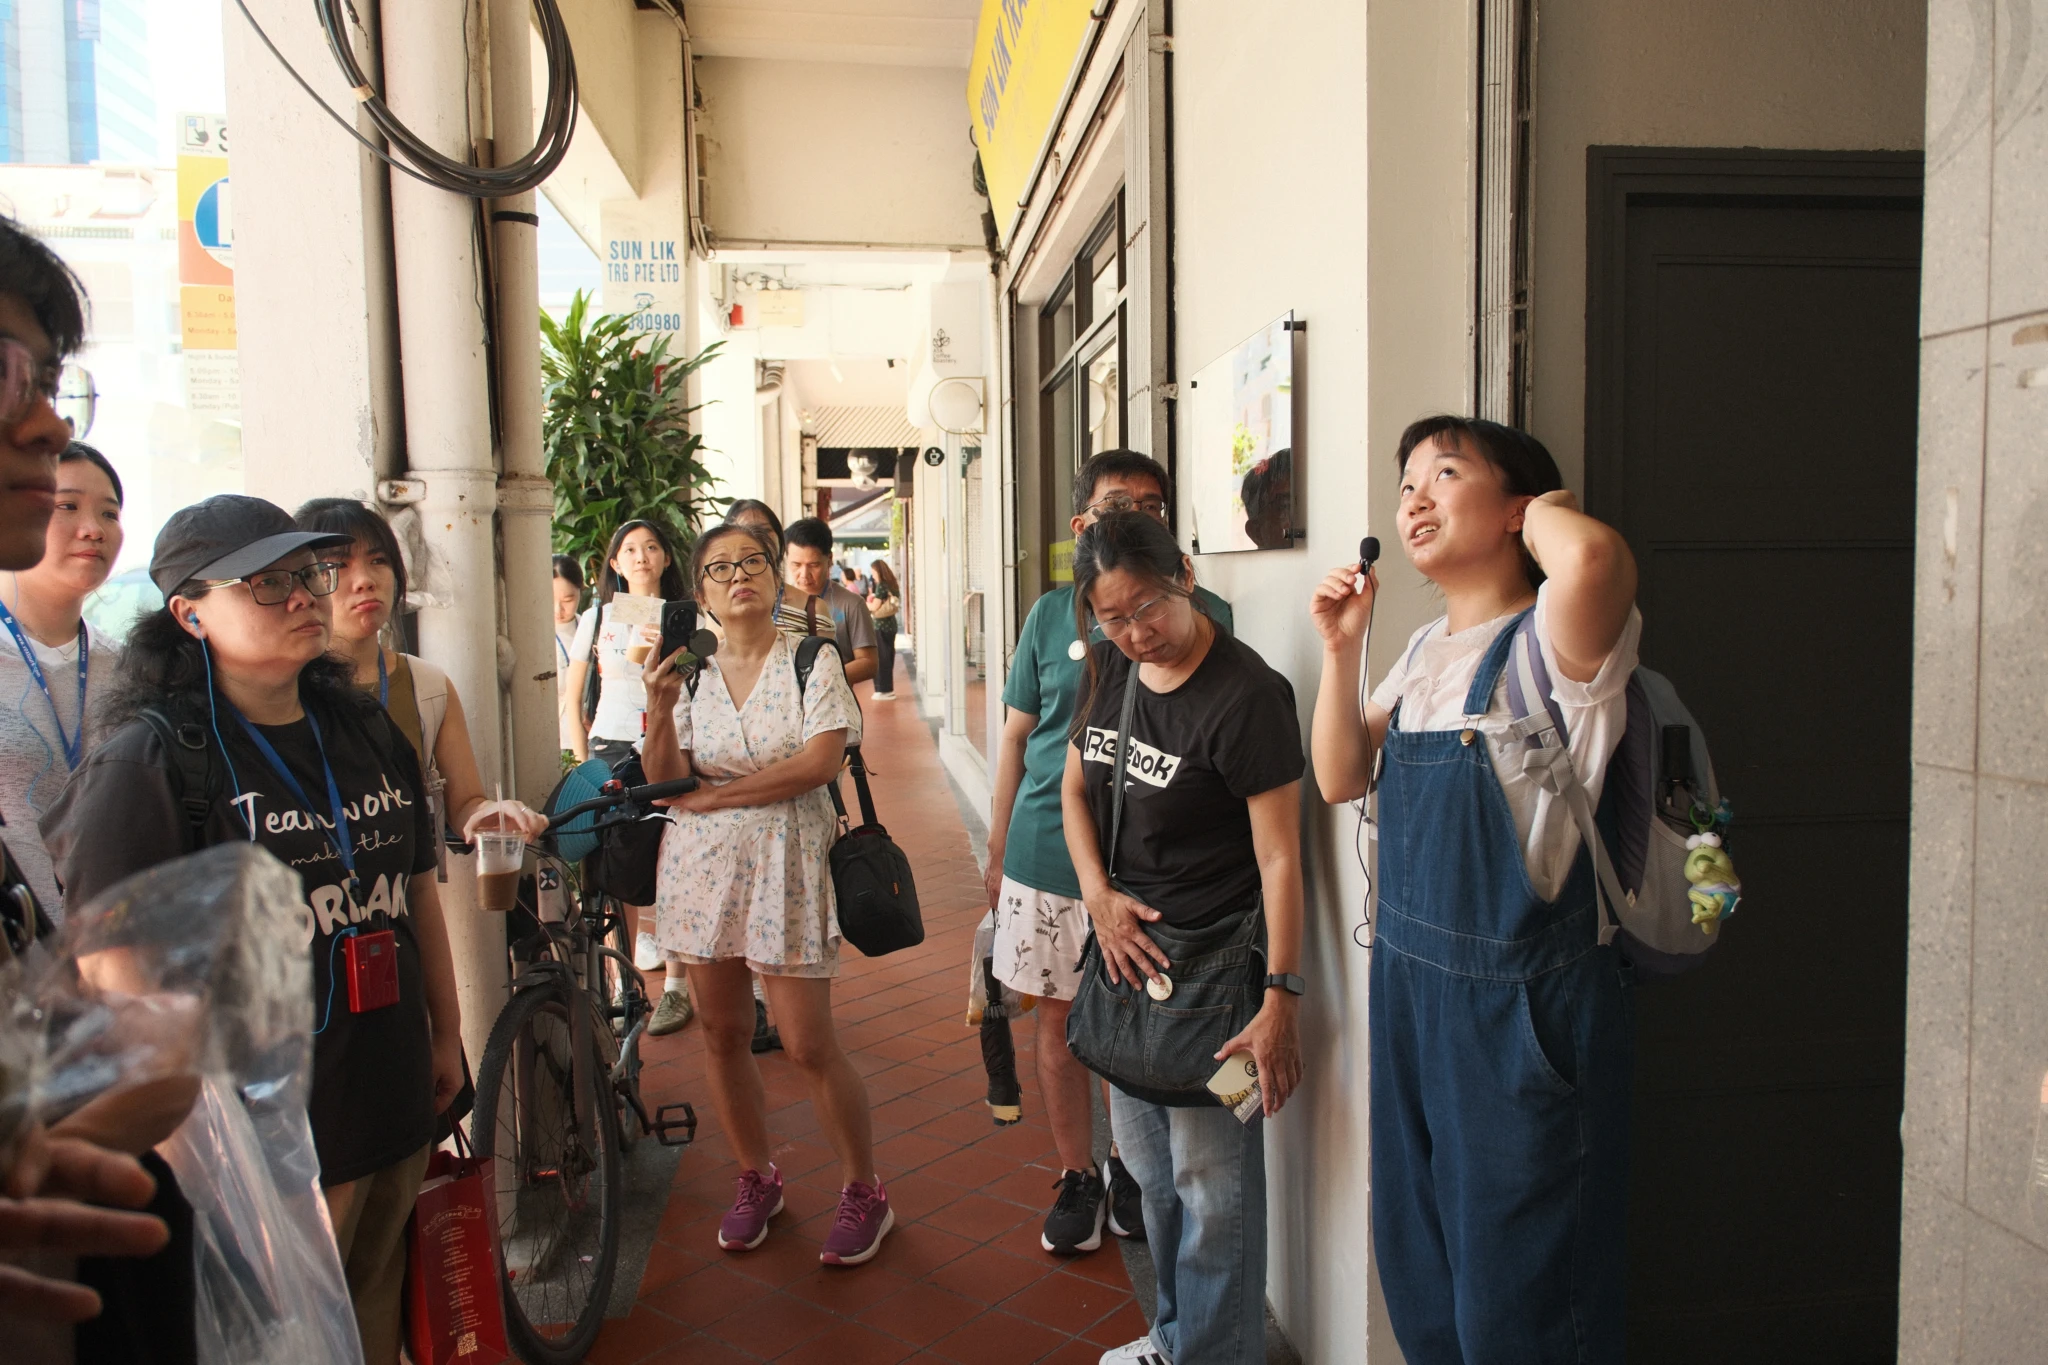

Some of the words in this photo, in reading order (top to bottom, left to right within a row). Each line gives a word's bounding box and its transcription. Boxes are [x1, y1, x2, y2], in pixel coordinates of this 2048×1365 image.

[610, 240, 642, 260] SUN
[651, 241, 675, 260] LIK
[608, 263, 629, 282] TRG
[634, 263, 655, 282] PTE
[660, 264, 679, 282] LTD
[230, 773, 412, 842] Teamwork
[356, 829, 403, 852] the
